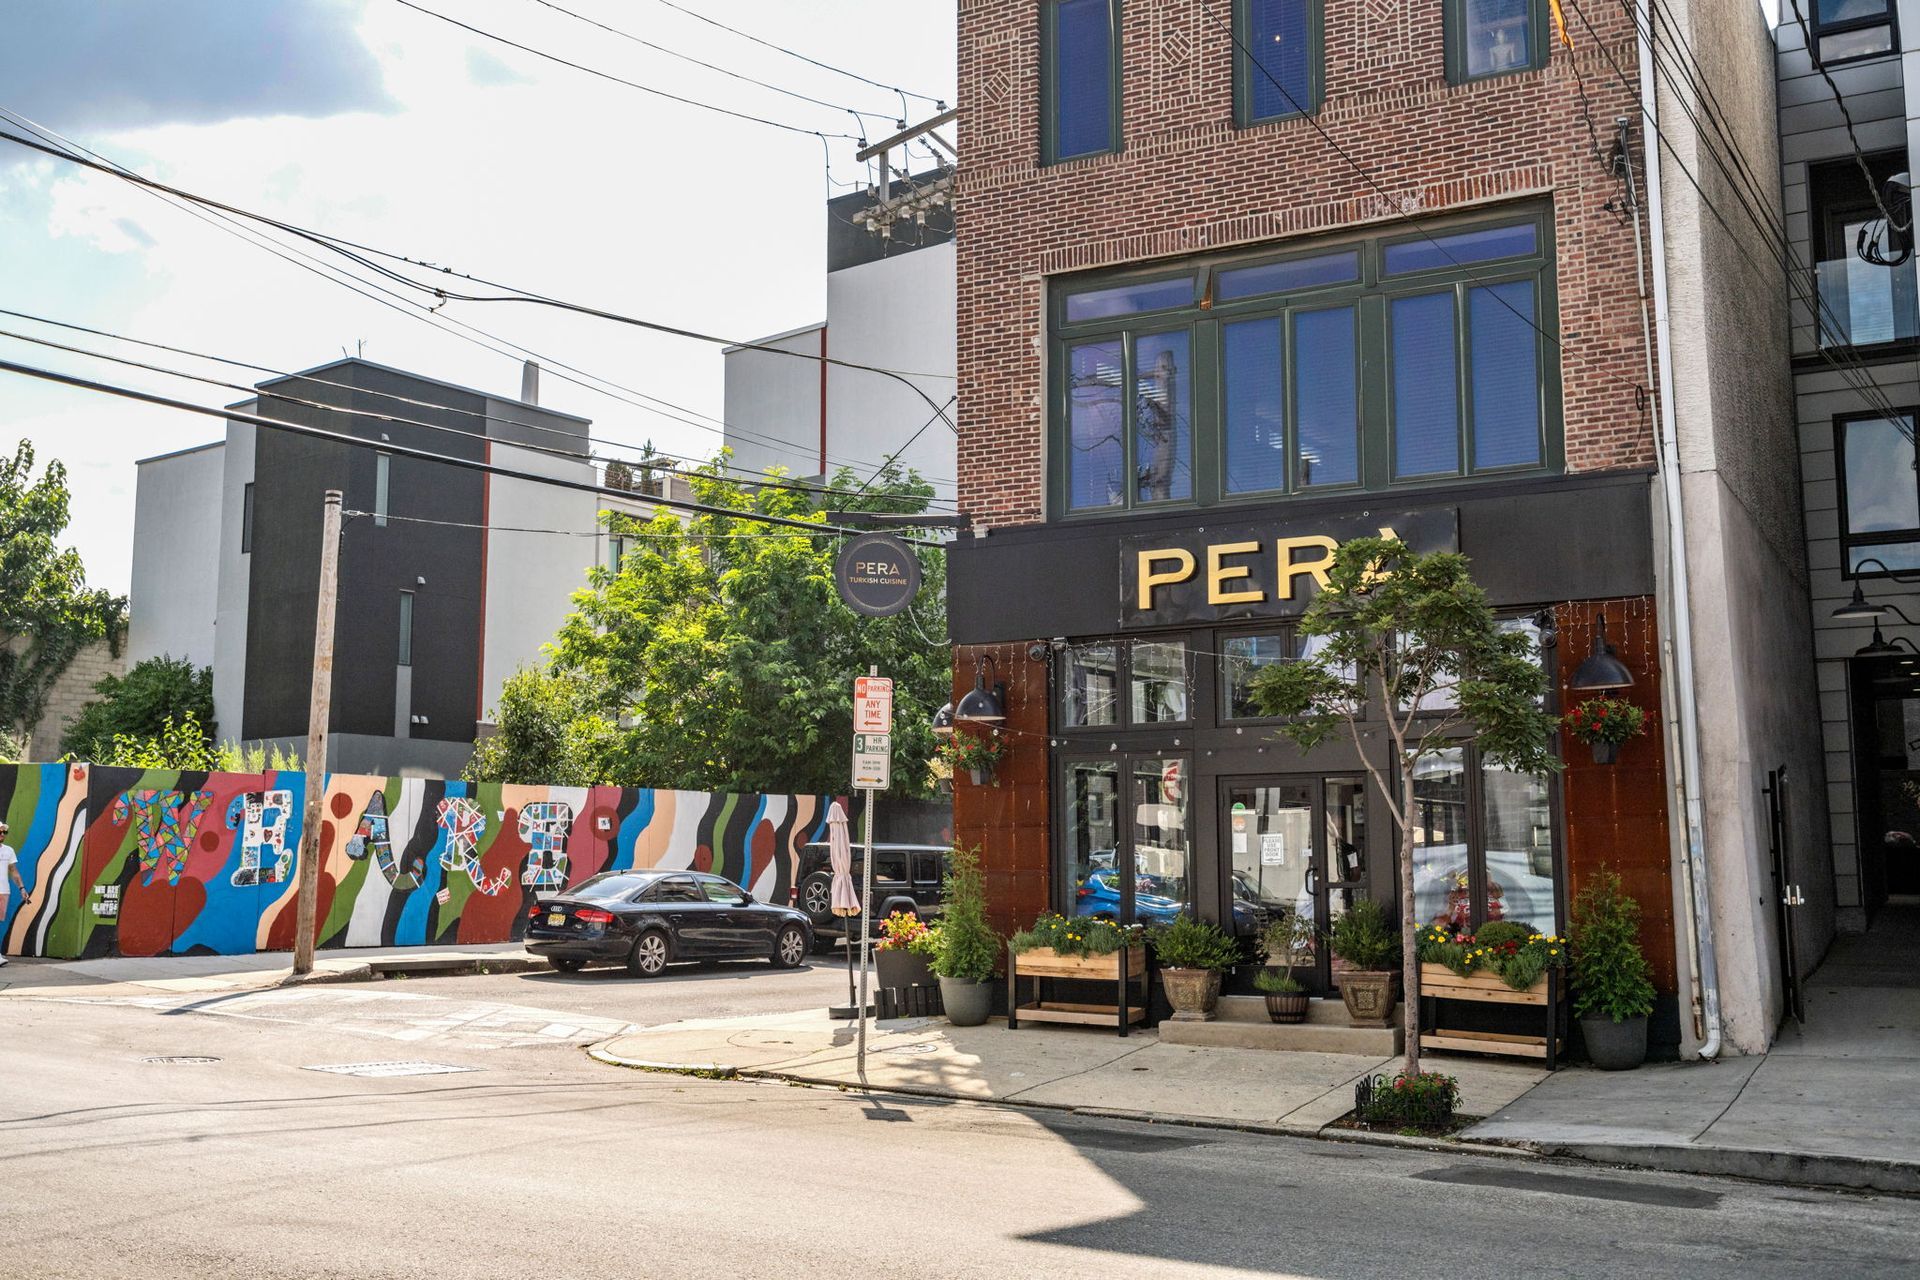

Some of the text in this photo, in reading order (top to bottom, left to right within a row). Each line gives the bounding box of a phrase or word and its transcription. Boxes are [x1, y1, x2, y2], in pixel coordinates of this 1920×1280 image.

[856, 562, 900, 575] PERA
[1138, 527, 1427, 610] PERA
[849, 576, 878, 584] TURKISH
[857, 683, 890, 694] NO PARKING
[866, 700, 881, 708] ANY
[864, 710, 881, 719] TIME
[856, 737, 864, 751] 3
[873, 736, 883, 744] HR
